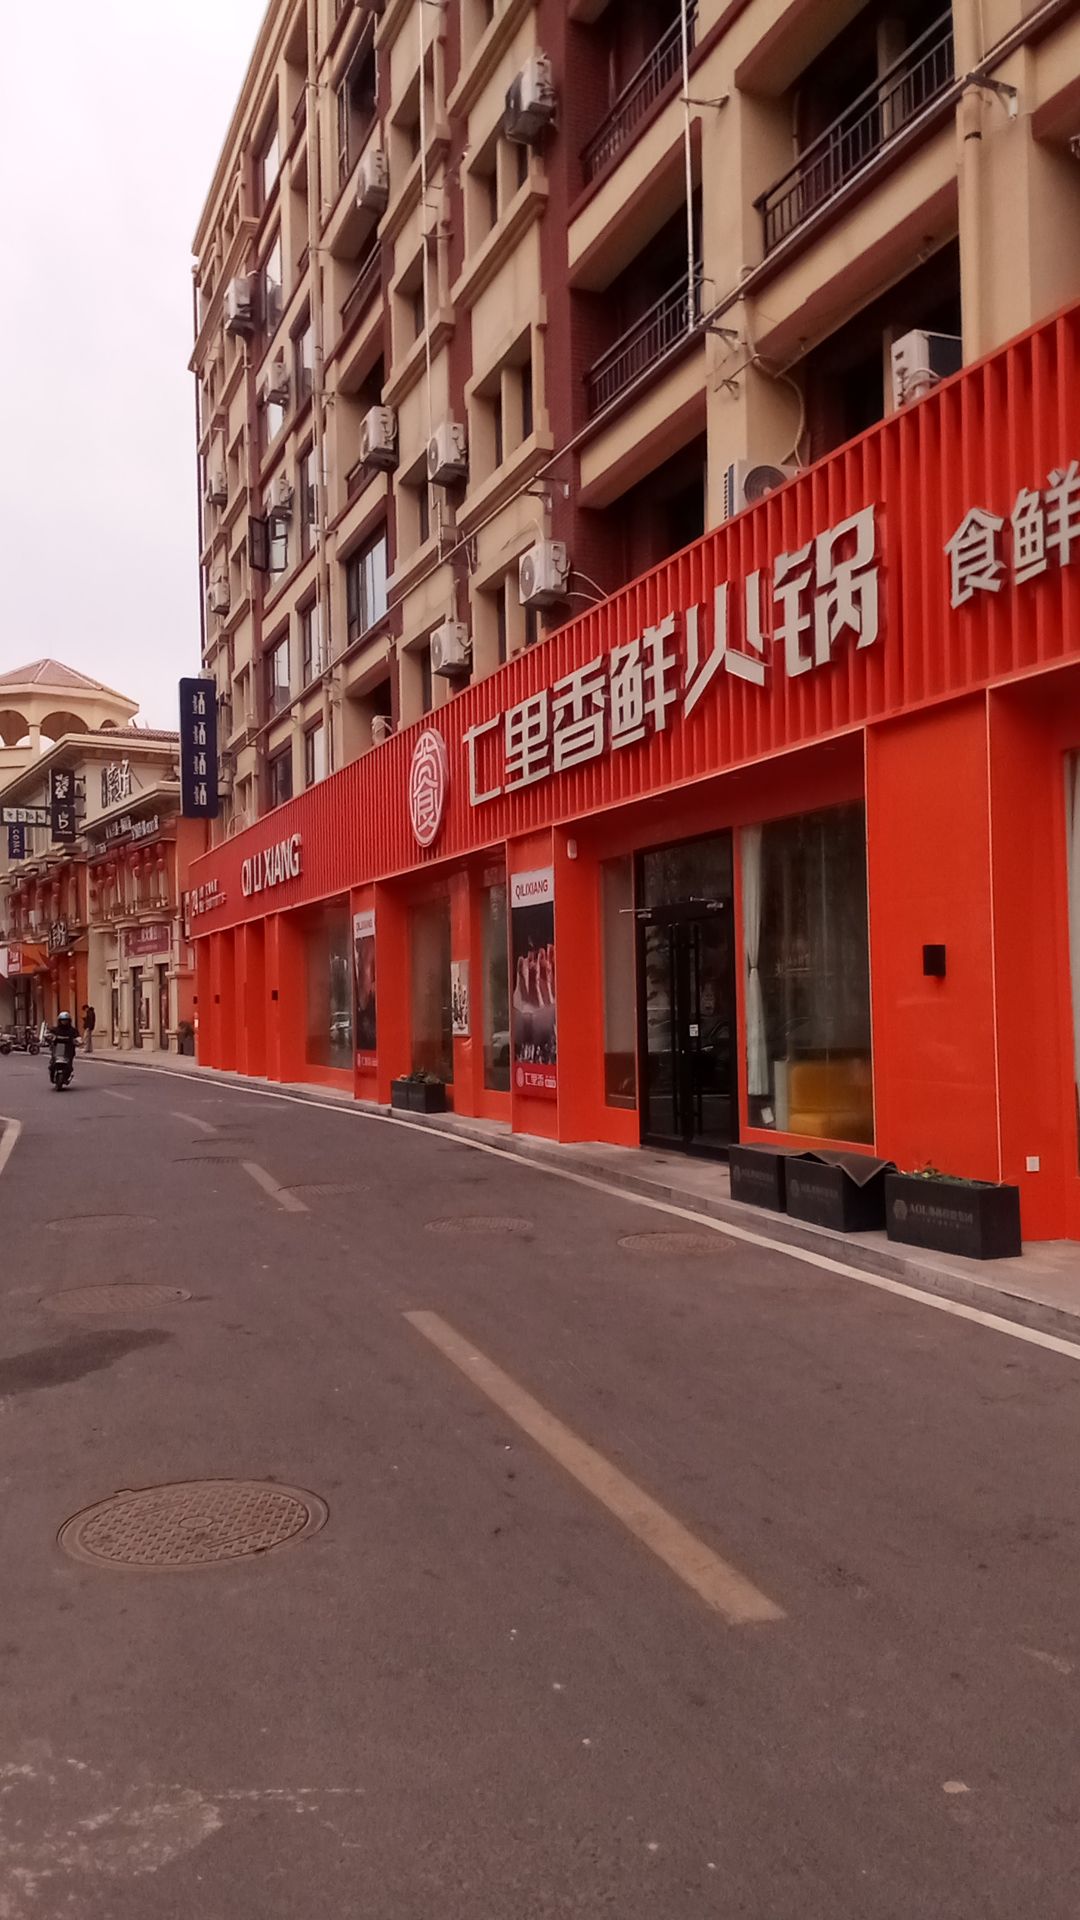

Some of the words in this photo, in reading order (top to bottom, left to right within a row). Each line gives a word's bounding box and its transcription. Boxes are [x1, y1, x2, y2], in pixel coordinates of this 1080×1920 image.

[462, 503, 881, 808] 七里香鲜火锅
